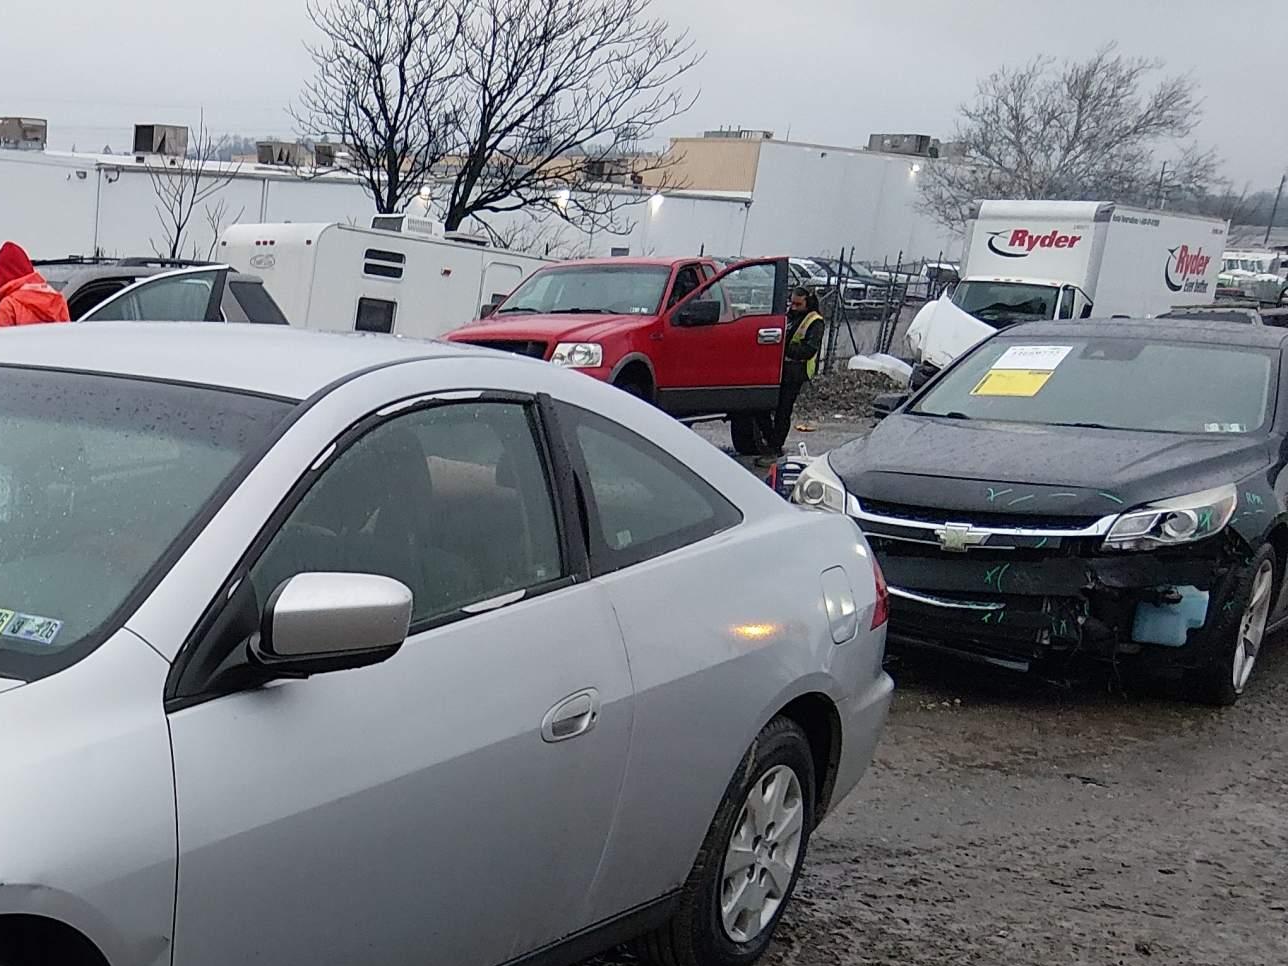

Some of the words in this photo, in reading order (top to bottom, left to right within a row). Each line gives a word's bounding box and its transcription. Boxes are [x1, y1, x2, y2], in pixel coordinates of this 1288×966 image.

[1009, 229, 1081, 251] Ryder
[1175, 245, 1211, 281] Ryder
[38, 621, 58, 639] 26
